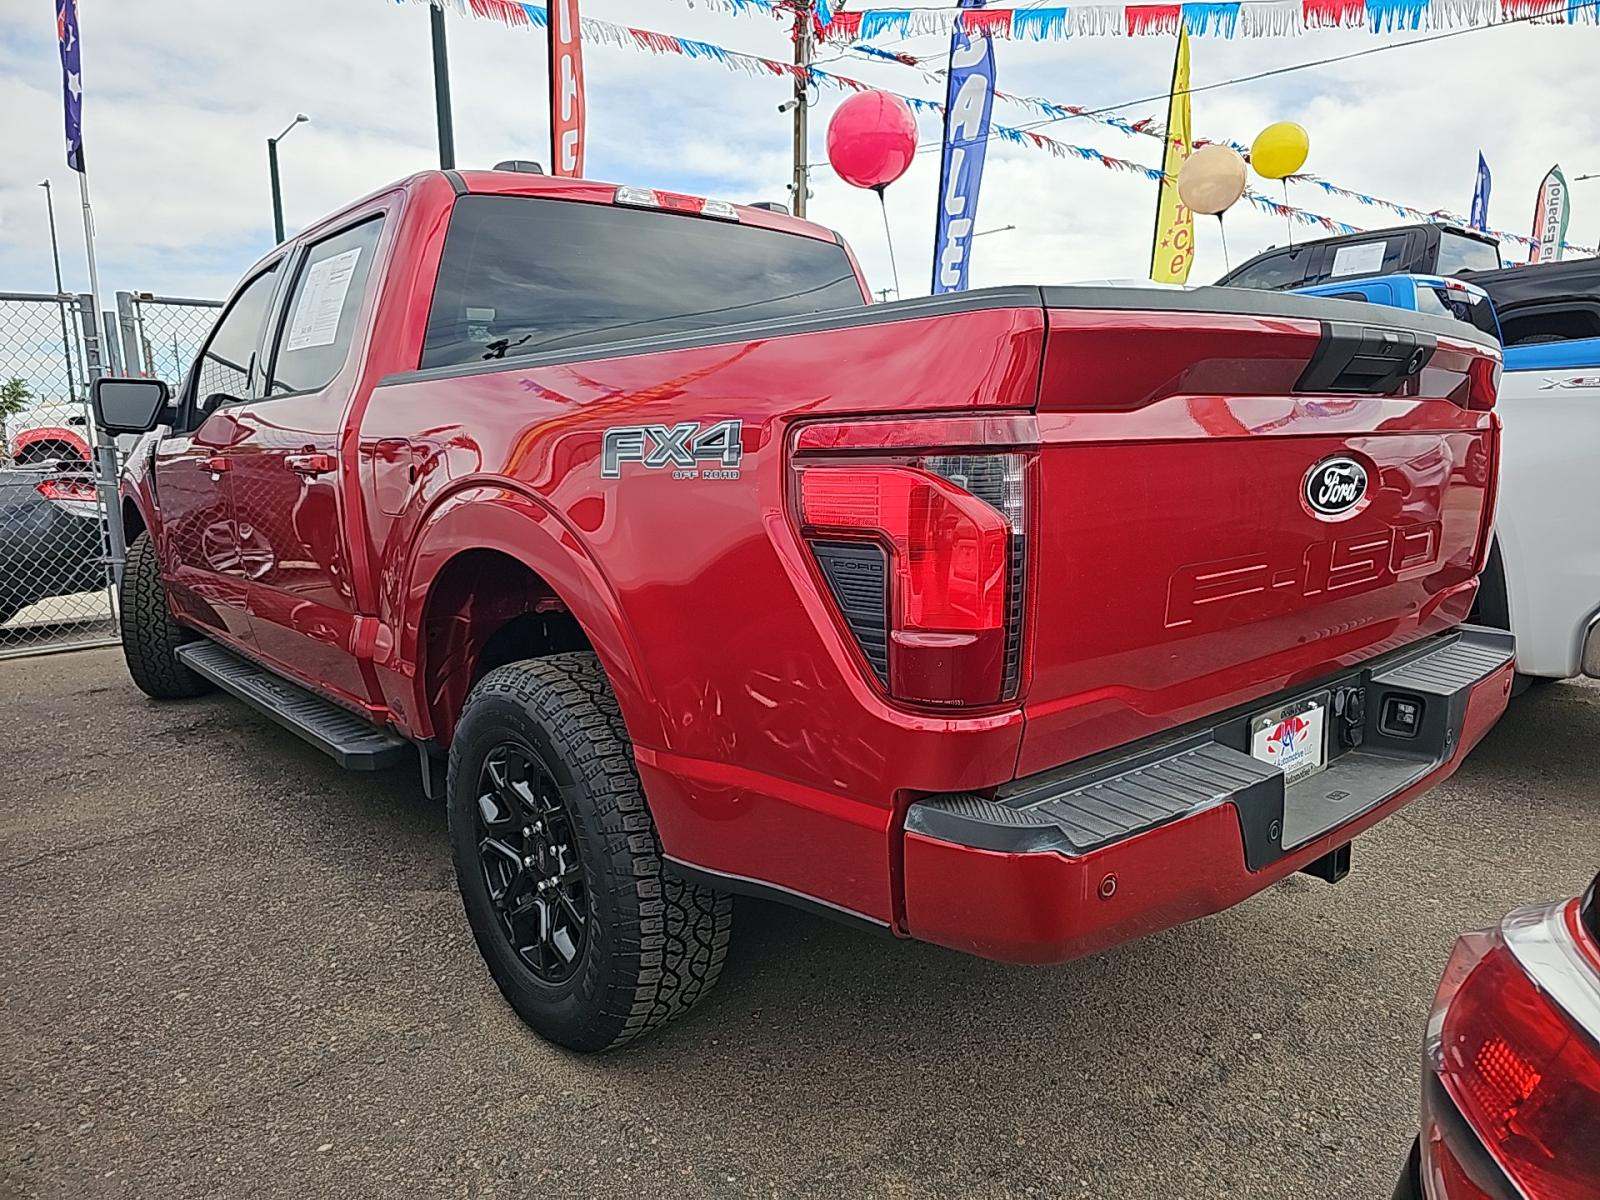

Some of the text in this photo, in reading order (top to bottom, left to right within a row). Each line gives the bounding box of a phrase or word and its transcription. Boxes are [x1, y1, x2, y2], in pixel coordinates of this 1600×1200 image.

[1543, 182, 1561, 244] Español
[600, 419, 743, 479] FX4
[672, 470, 741, 480] OFF ROAD
[833, 561, 883, 572] FORD
[1164, 520, 1443, 629] F-150
